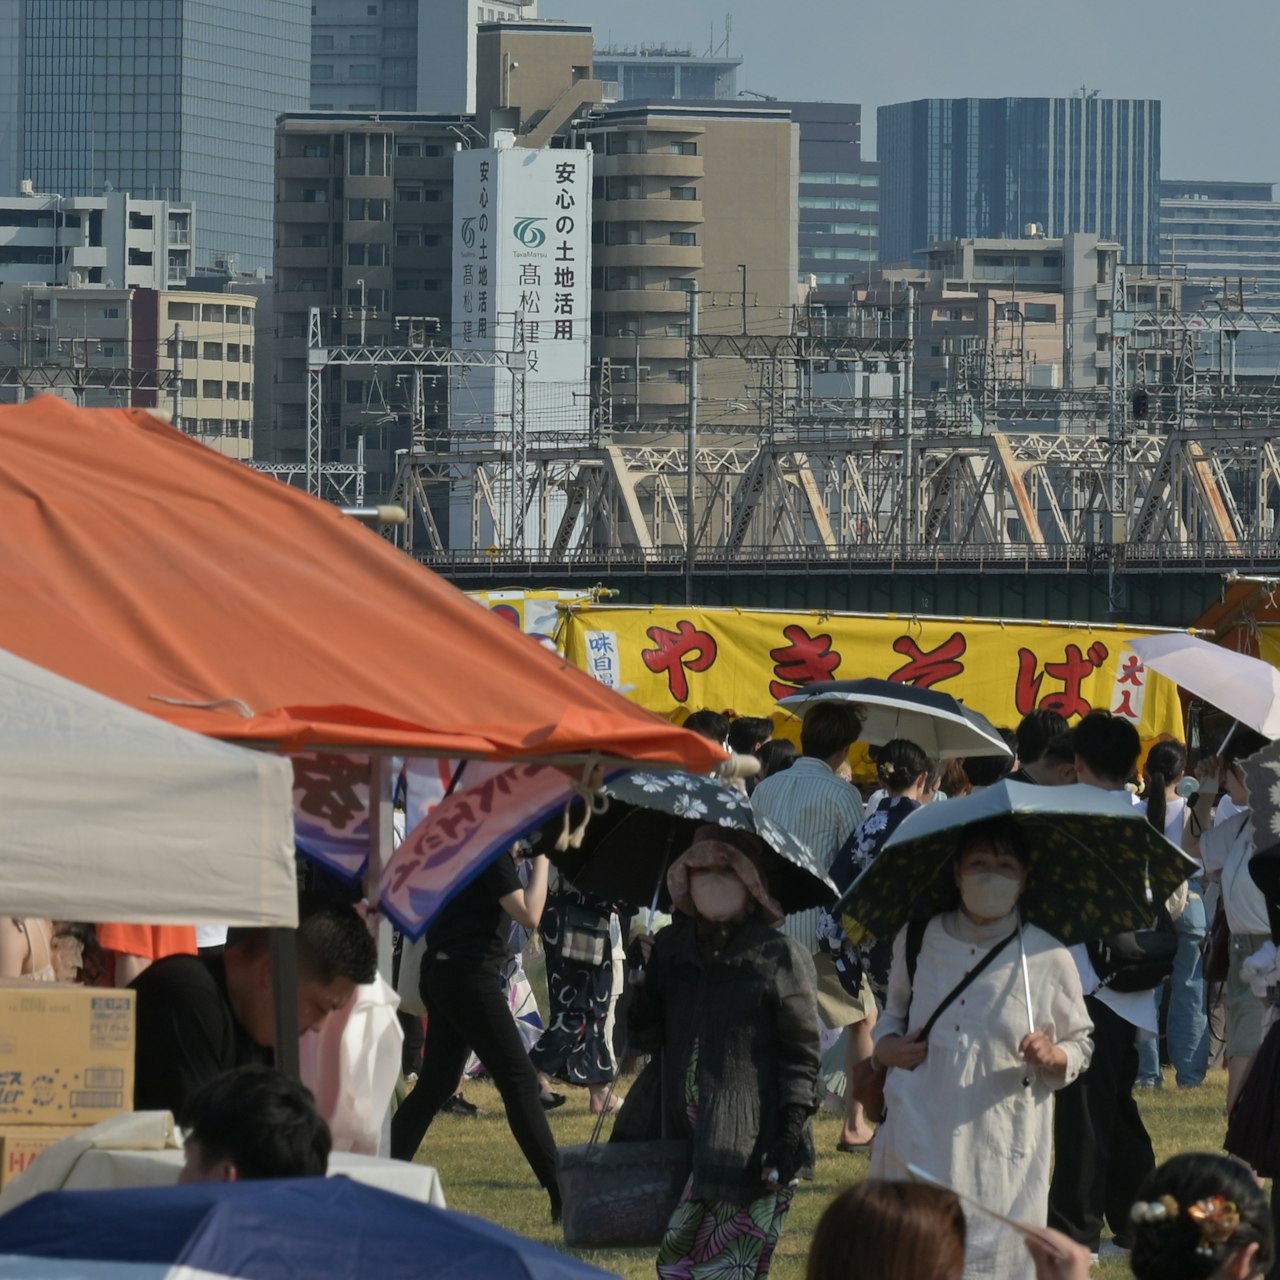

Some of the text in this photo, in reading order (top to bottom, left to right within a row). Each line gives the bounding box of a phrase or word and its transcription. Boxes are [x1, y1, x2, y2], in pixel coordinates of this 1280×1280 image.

[477, 160, 489, 339] 安心の土地活用
[512, 250, 548, 259] TakaMatsu
[553, 162, 576, 340] 安心の土地活用
[641, 620, 1109, 719] やきそば
